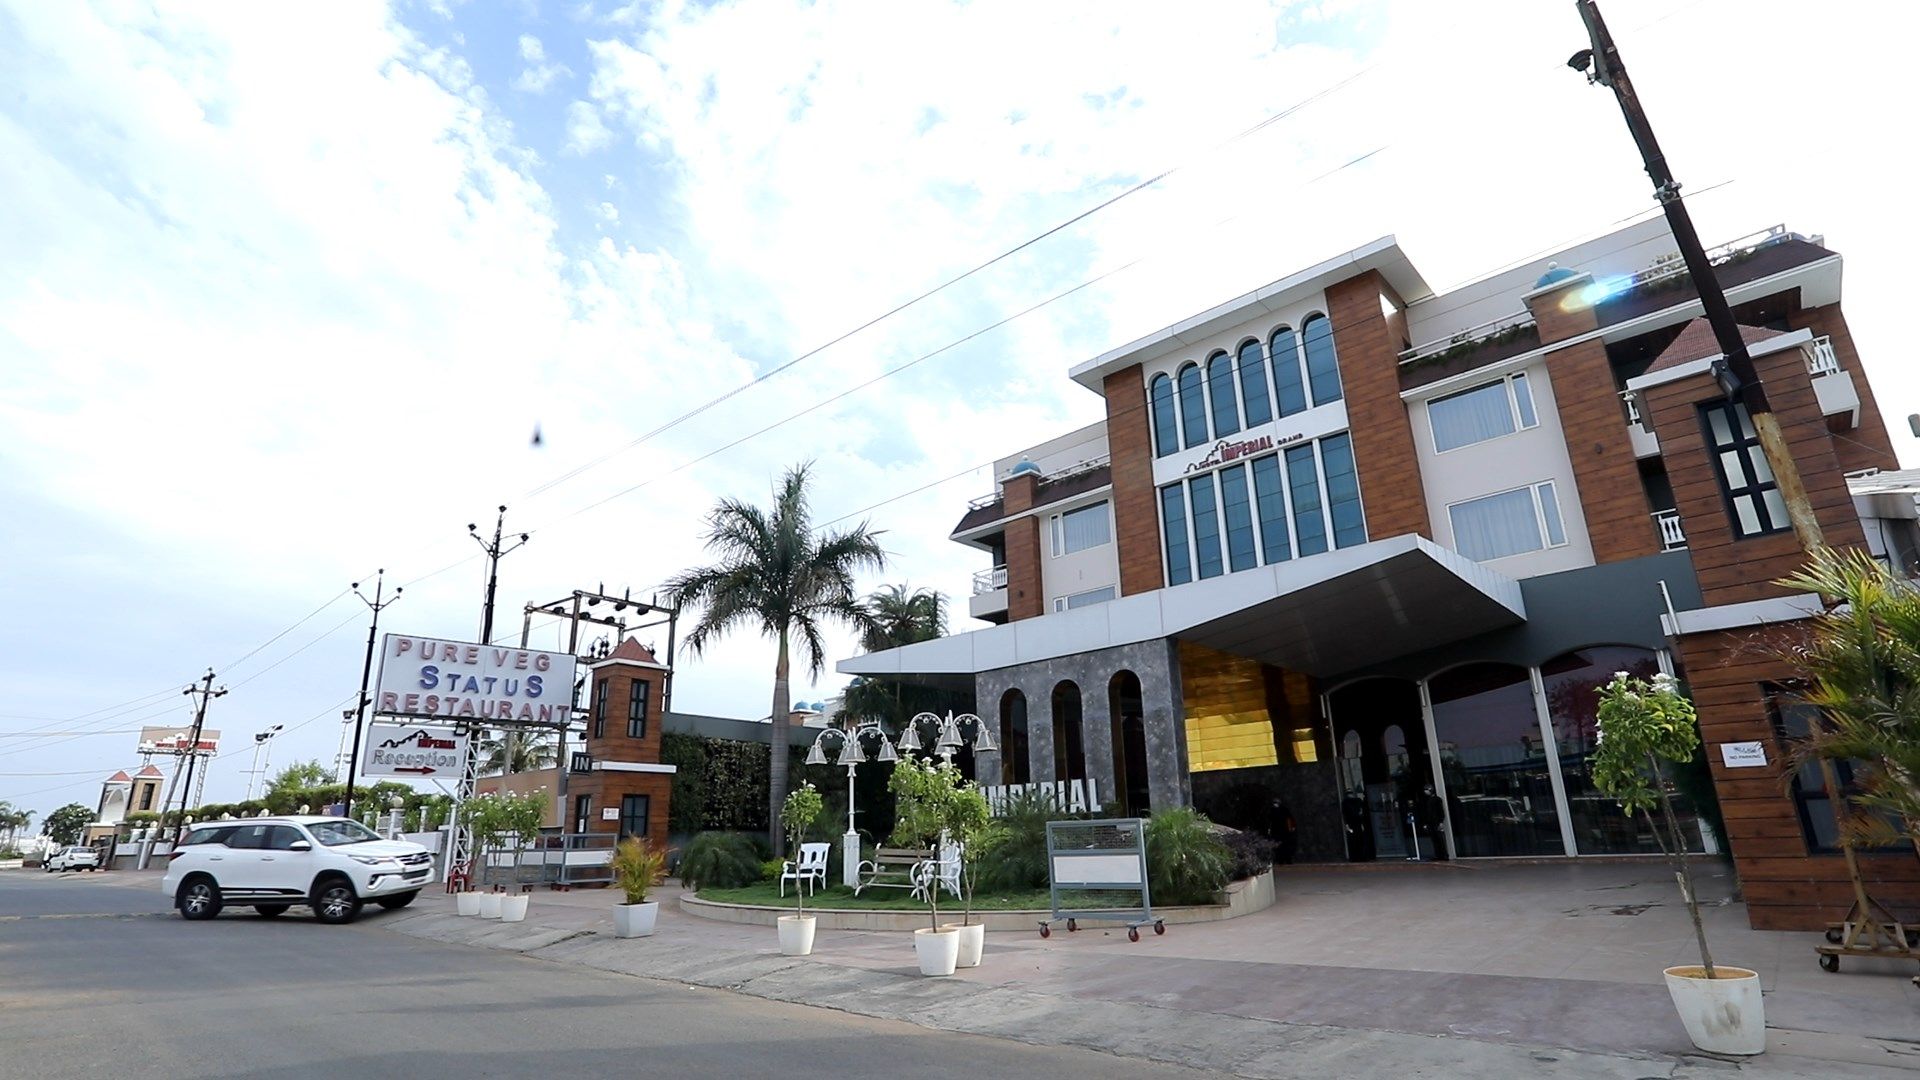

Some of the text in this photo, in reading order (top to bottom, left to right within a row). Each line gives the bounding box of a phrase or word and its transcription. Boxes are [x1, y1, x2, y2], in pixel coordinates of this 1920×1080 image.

[1220, 435, 1274, 462] IMPERIAL
[1277, 433, 1303, 445] GRAND
[396, 638, 551, 671] PURE VEG
[419, 665, 543, 698] STATUS
[380, 691, 570, 723] RESTAURANT
[371, 749, 457, 769] Reception
[574, 756, 590, 771] IN
